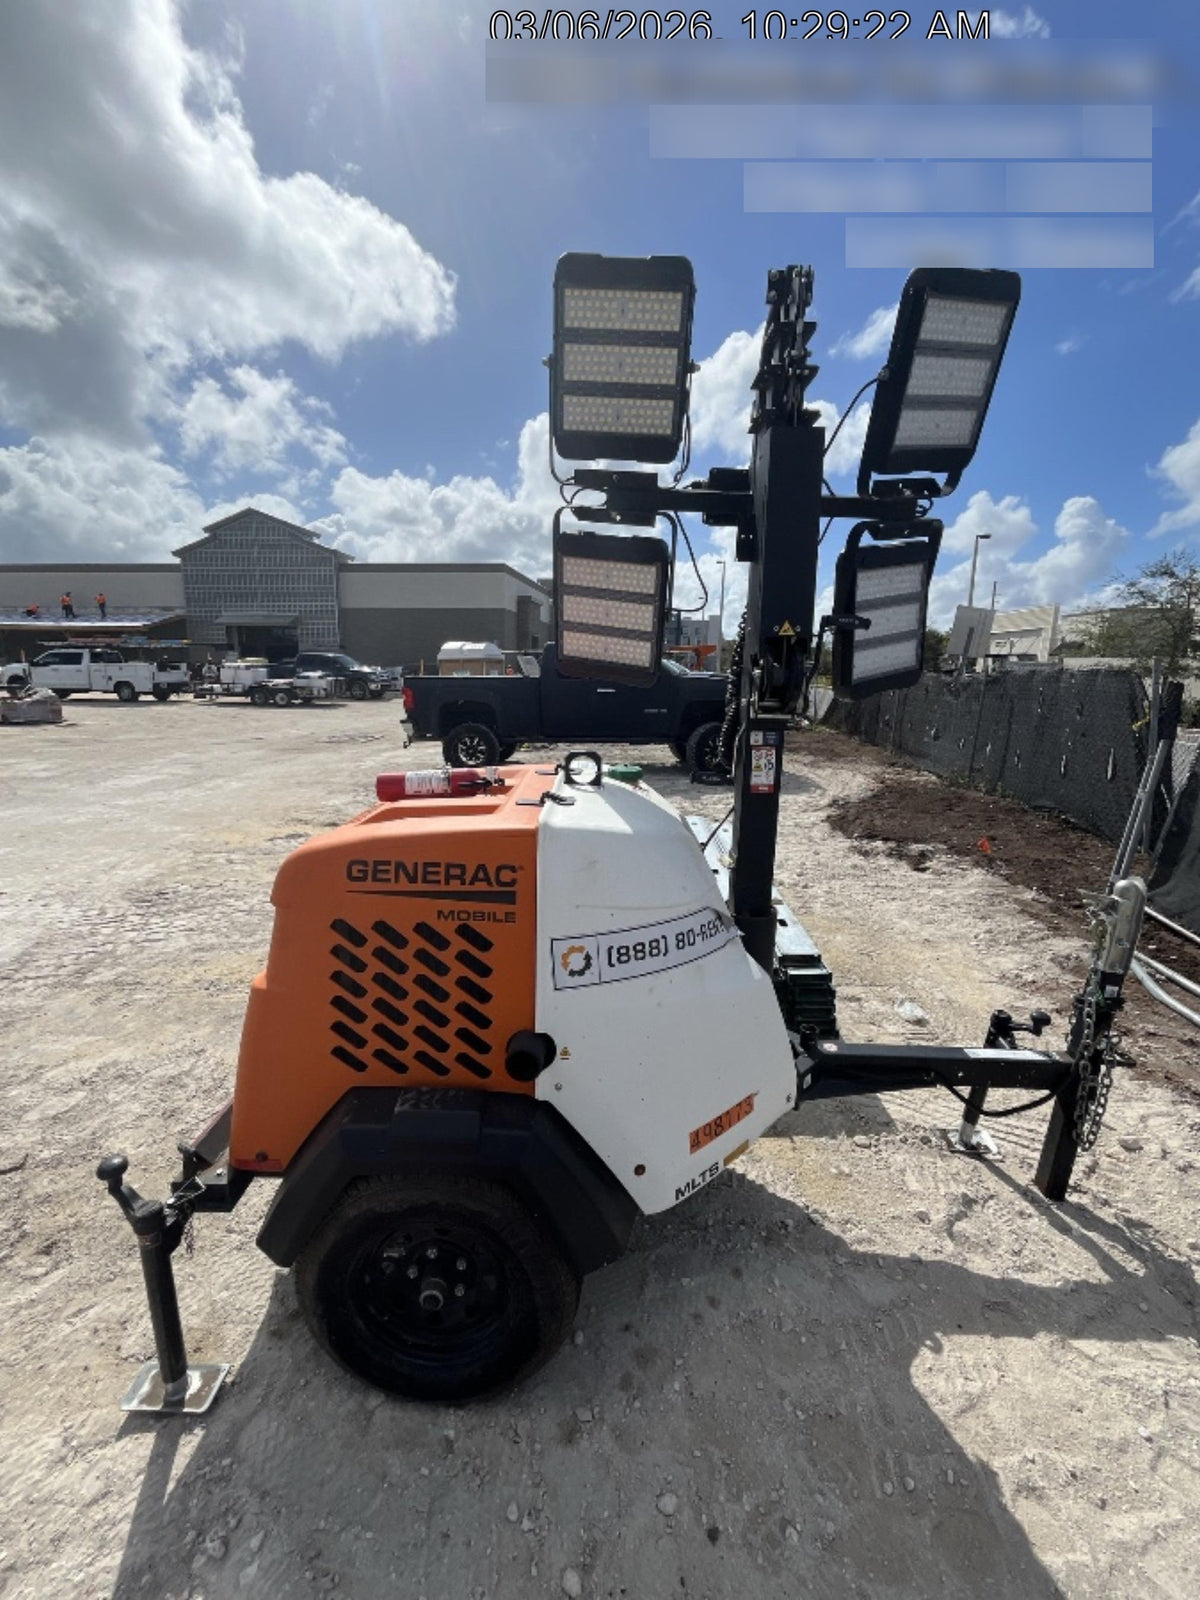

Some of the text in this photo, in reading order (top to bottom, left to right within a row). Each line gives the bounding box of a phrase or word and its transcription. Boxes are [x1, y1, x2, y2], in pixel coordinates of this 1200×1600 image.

[346, 859, 518, 888] GENERAC
[437, 909, 516, 923] MOBILE
[607, 935, 669, 968] (888)
